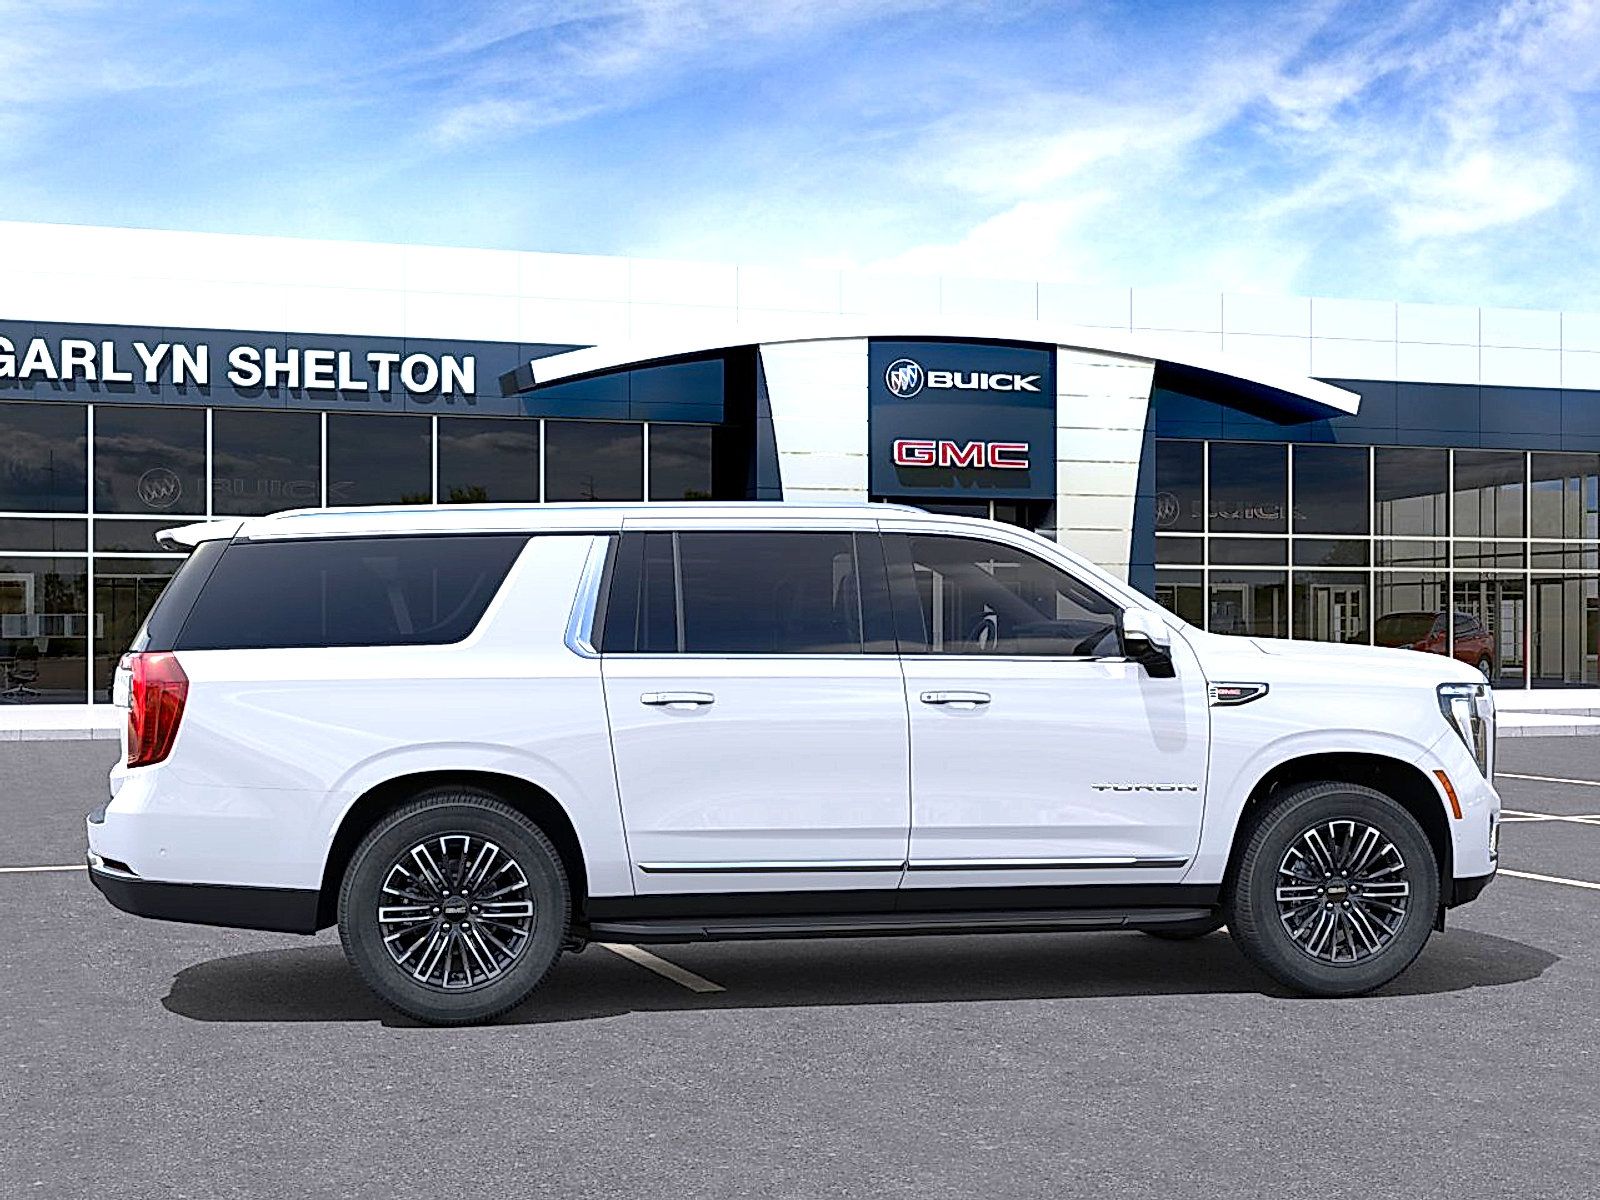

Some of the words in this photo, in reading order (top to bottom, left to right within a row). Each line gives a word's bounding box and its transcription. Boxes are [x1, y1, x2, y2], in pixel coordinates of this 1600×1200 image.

[228, 346, 475, 394] SHELTON
[927, 371, 1041, 392] BUICK
[893, 439, 1029, 469] GMC
